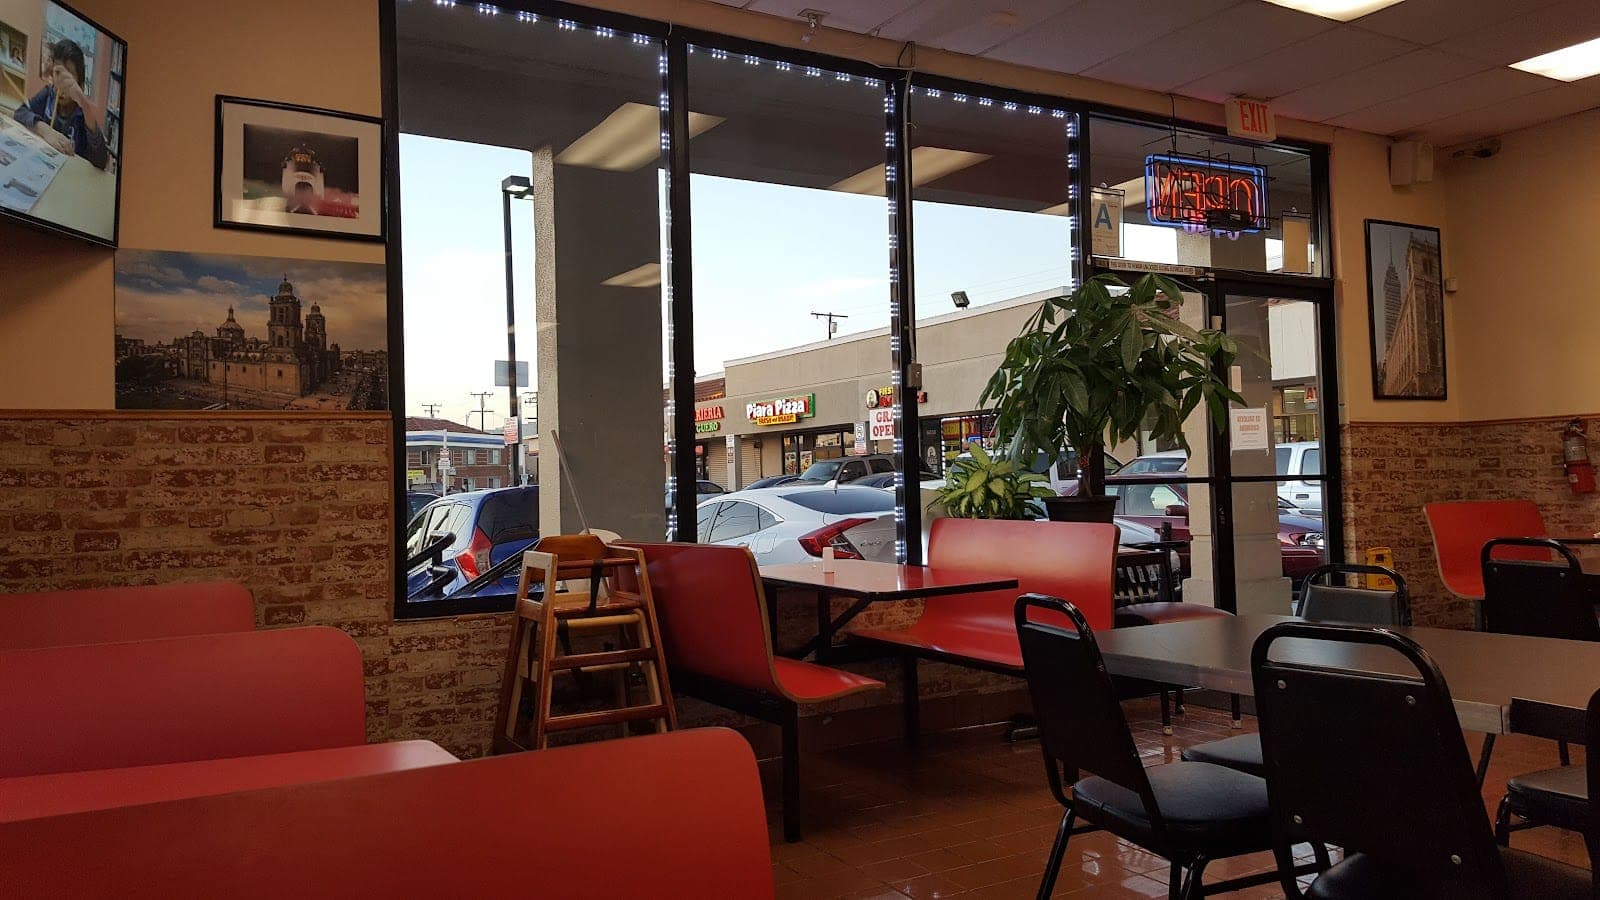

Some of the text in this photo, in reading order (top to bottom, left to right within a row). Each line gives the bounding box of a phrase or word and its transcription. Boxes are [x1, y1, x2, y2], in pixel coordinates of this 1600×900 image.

[1240, 101, 1268, 133] EXIT
[1094, 203, 1113, 230] A
[746, 399, 805, 419] Piara Pizza
